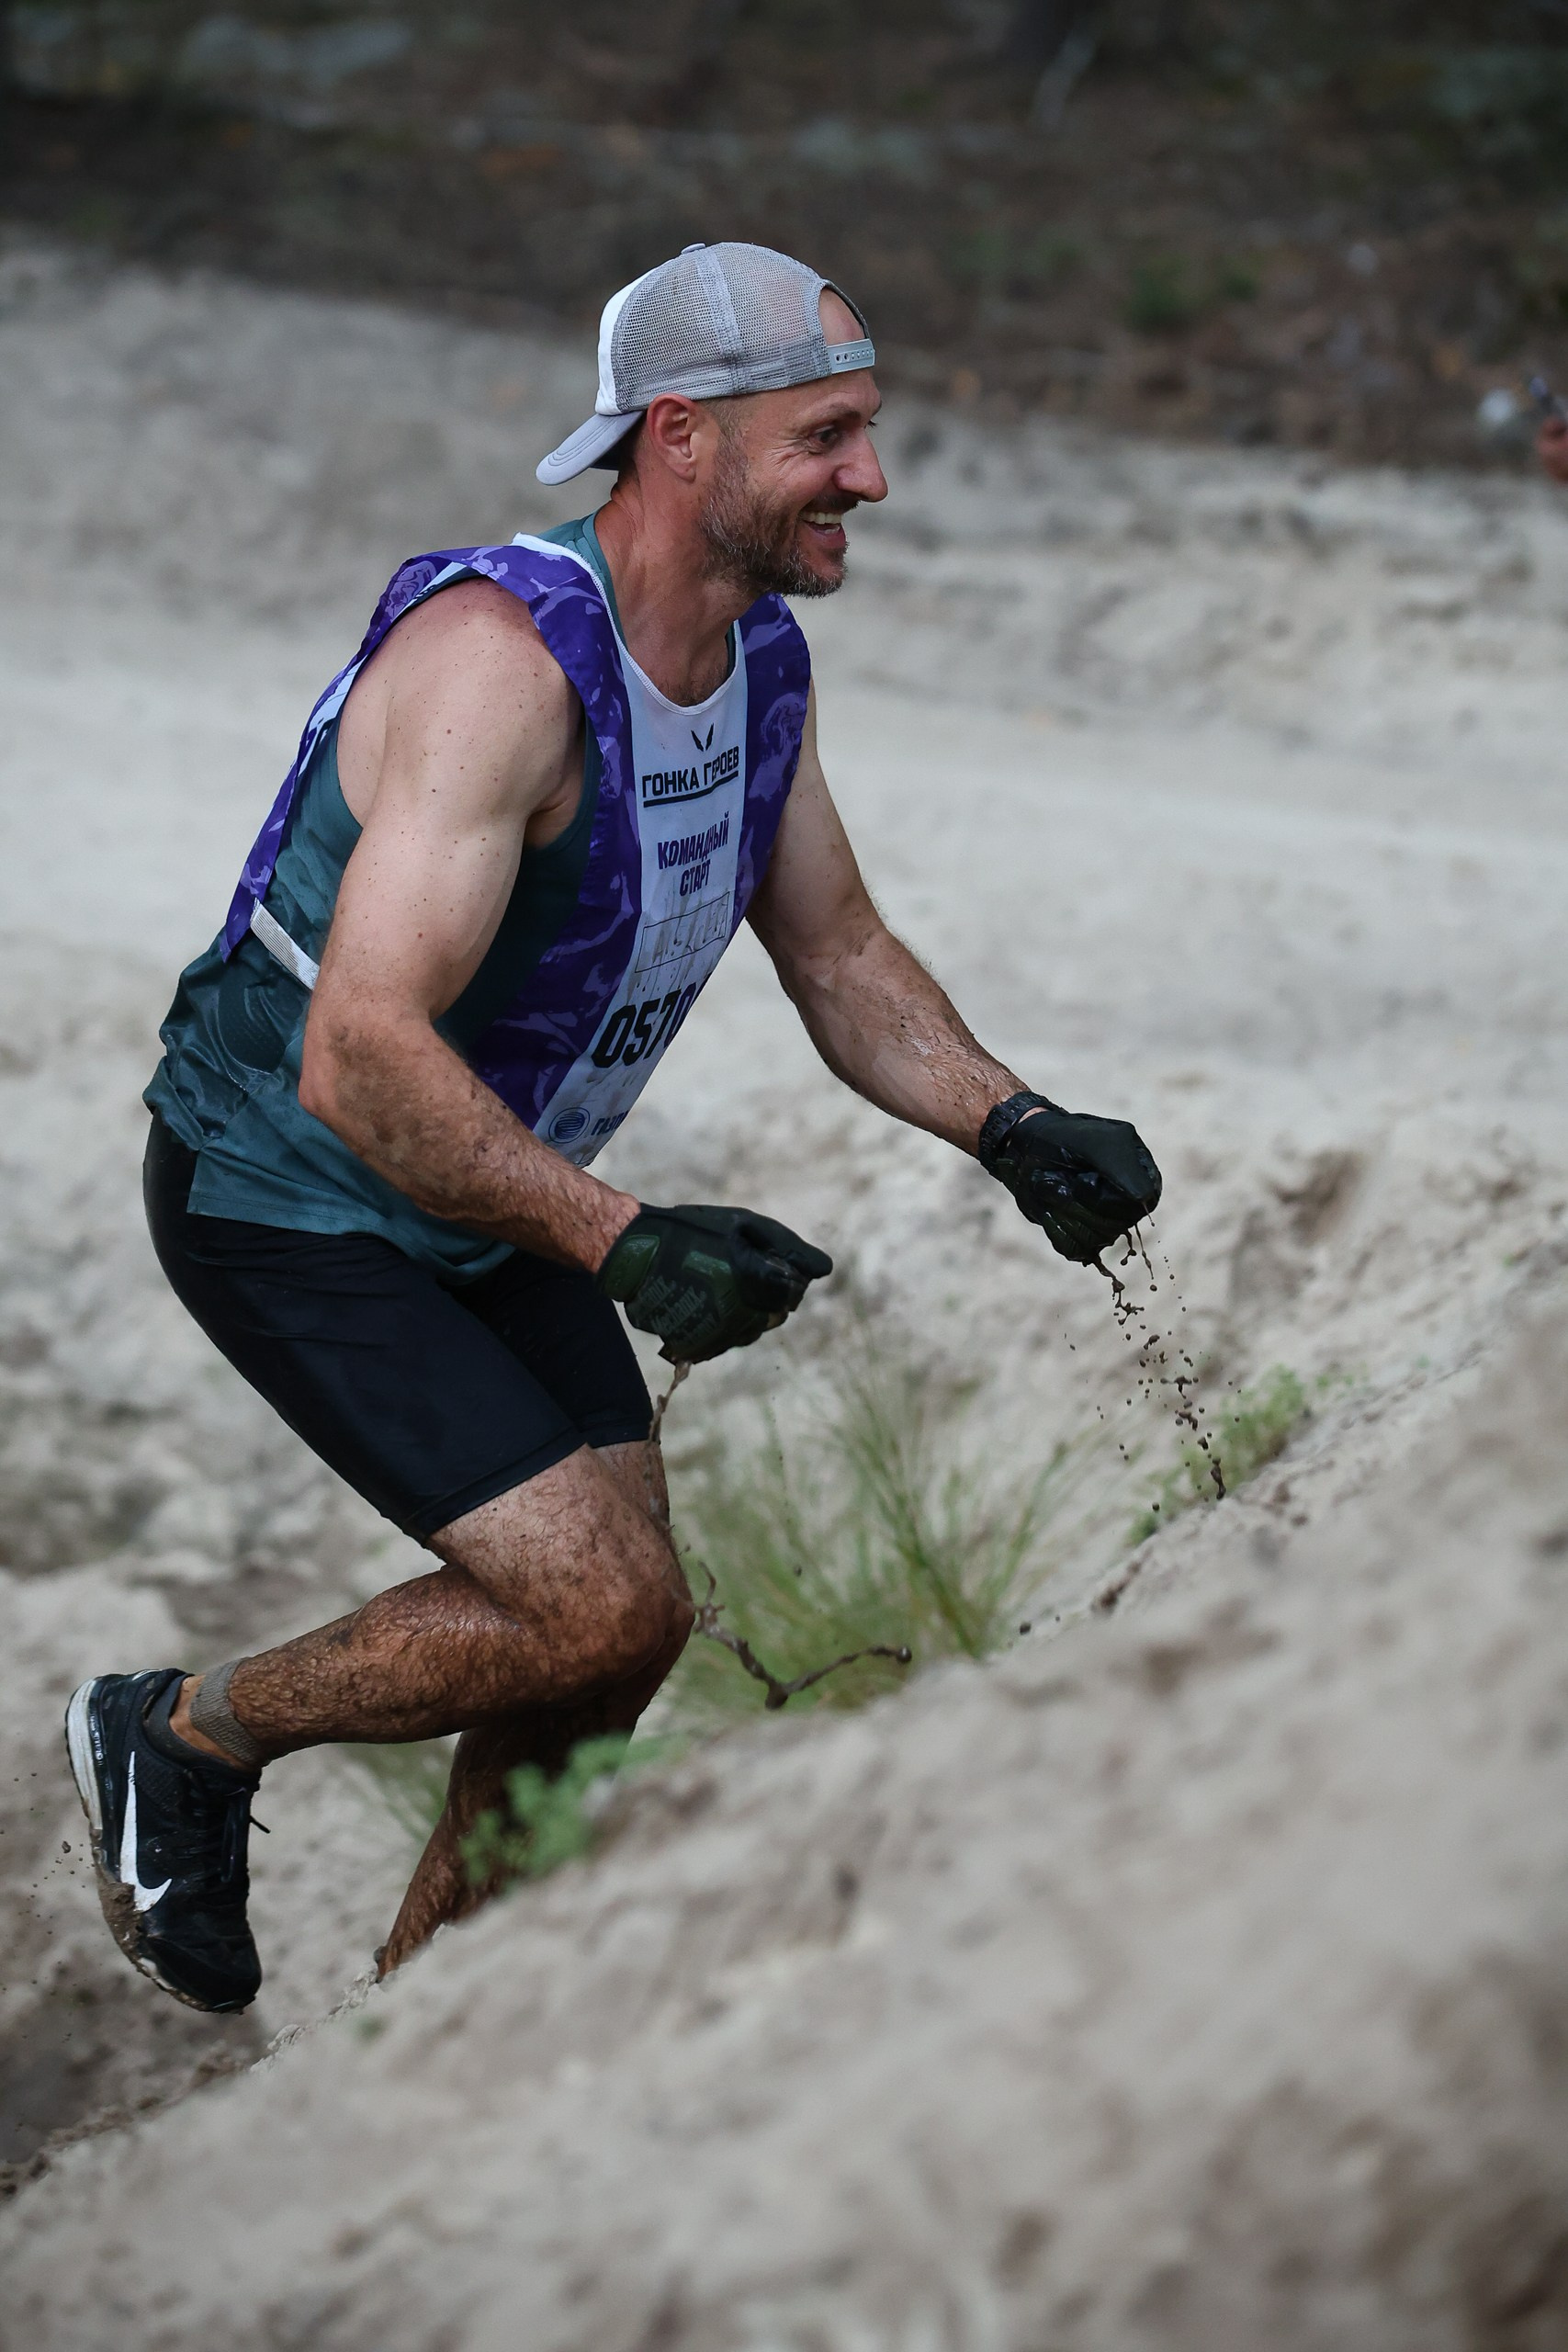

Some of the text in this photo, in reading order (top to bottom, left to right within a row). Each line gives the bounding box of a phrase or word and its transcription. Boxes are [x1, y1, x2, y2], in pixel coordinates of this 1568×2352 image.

[641, 745, 739, 798] ГОНКА ГЕРОЕВ
[657, 810, 729, 870] КОМАНДНЫЙ
[679, 858, 711, 897] СТАРТ
[591, 971, 712, 1069] 0570
